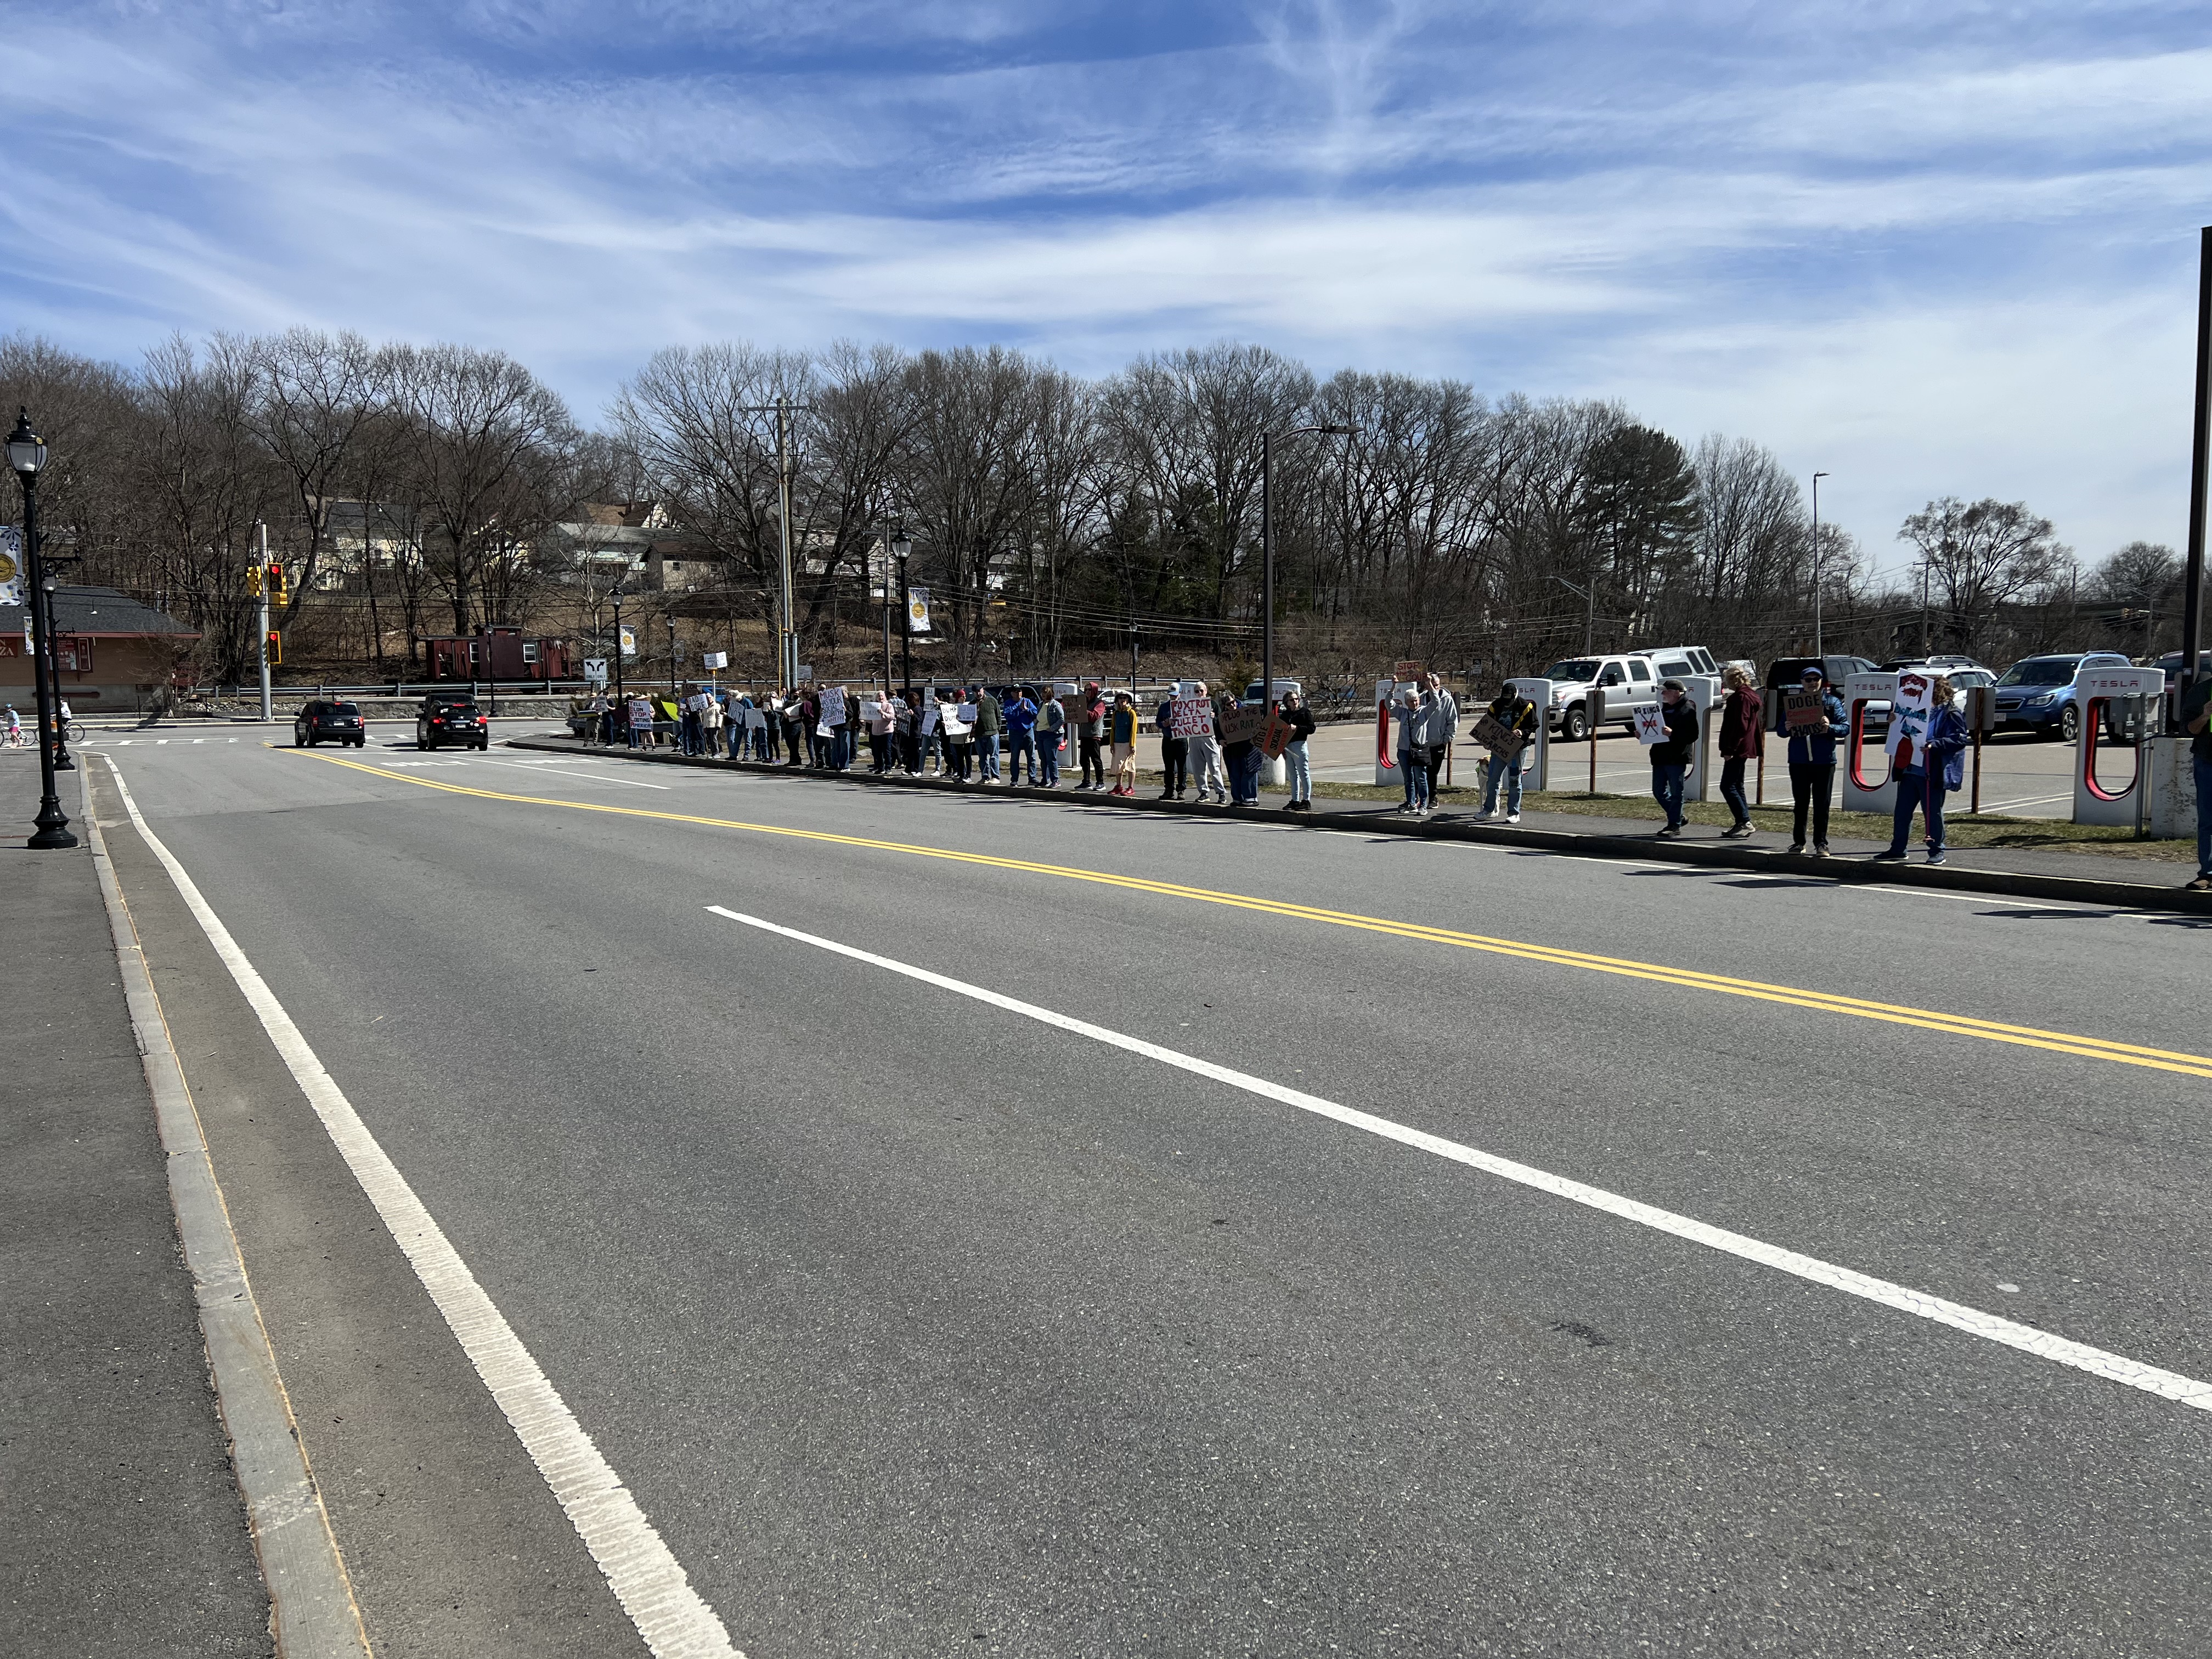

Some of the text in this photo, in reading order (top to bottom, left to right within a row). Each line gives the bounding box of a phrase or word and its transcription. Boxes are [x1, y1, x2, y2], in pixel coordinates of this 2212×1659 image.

[1397, 662, 1419, 670] STOP
[1406, 673, 1427, 681] COUP
[820, 688, 839, 699] MUSK
[688, 696, 699, 704] BAD
[829, 695, 843, 705] YOUR
[1171, 698, 1211, 711] FOXTROT
[1788, 695, 1820, 709] DOGE
[691, 702, 706, 712] DOGE
[822, 704, 840, 713] SOCIAL
[942, 706, 957, 714] DUMP
[1245, 707, 1257, 716] THE
[1643, 706, 1660, 714] KINGS
[1172, 709, 1201, 718] DELTA
[1171, 715, 1206, 727] JULIET
[1171, 724, 1210, 737] TANGO
[1489, 723, 1516, 746] KINGS
[1255, 726, 1268, 748] DOGE
[1270, 729, 1283, 750] SOCIAL
[1471, 729, 1509, 758] OLIGARCHS
